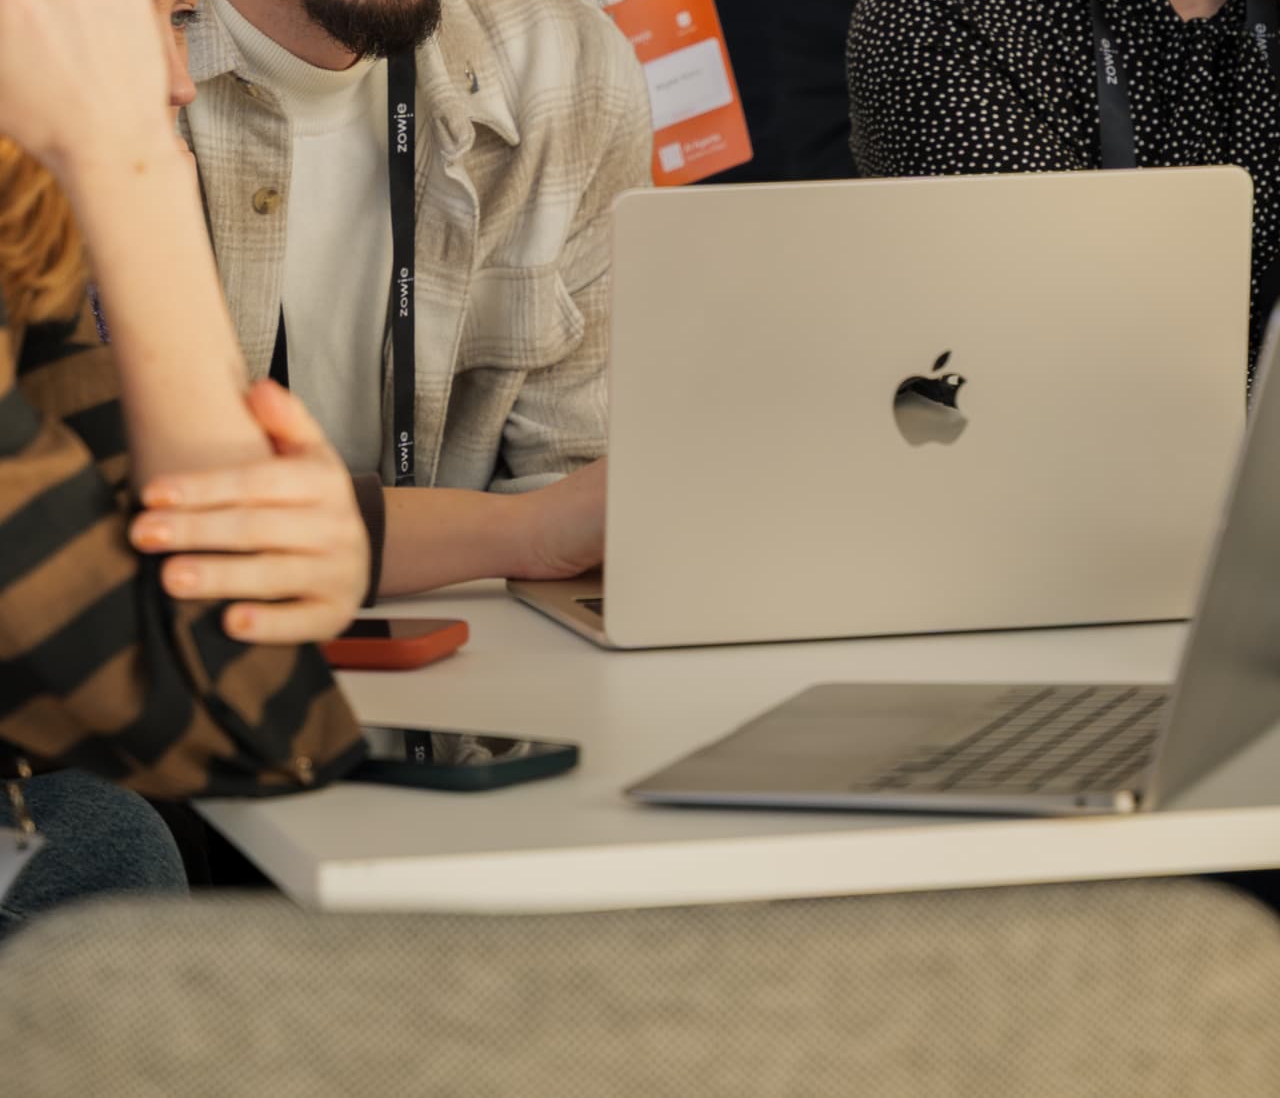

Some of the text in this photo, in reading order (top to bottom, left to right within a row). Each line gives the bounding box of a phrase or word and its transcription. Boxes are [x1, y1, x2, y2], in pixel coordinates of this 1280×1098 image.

[1099, 37, 1119, 85] zowie
[393, 103, 414, 153] zowie
[397, 267, 413, 317] zowie
[398, 431, 413, 472] owie
